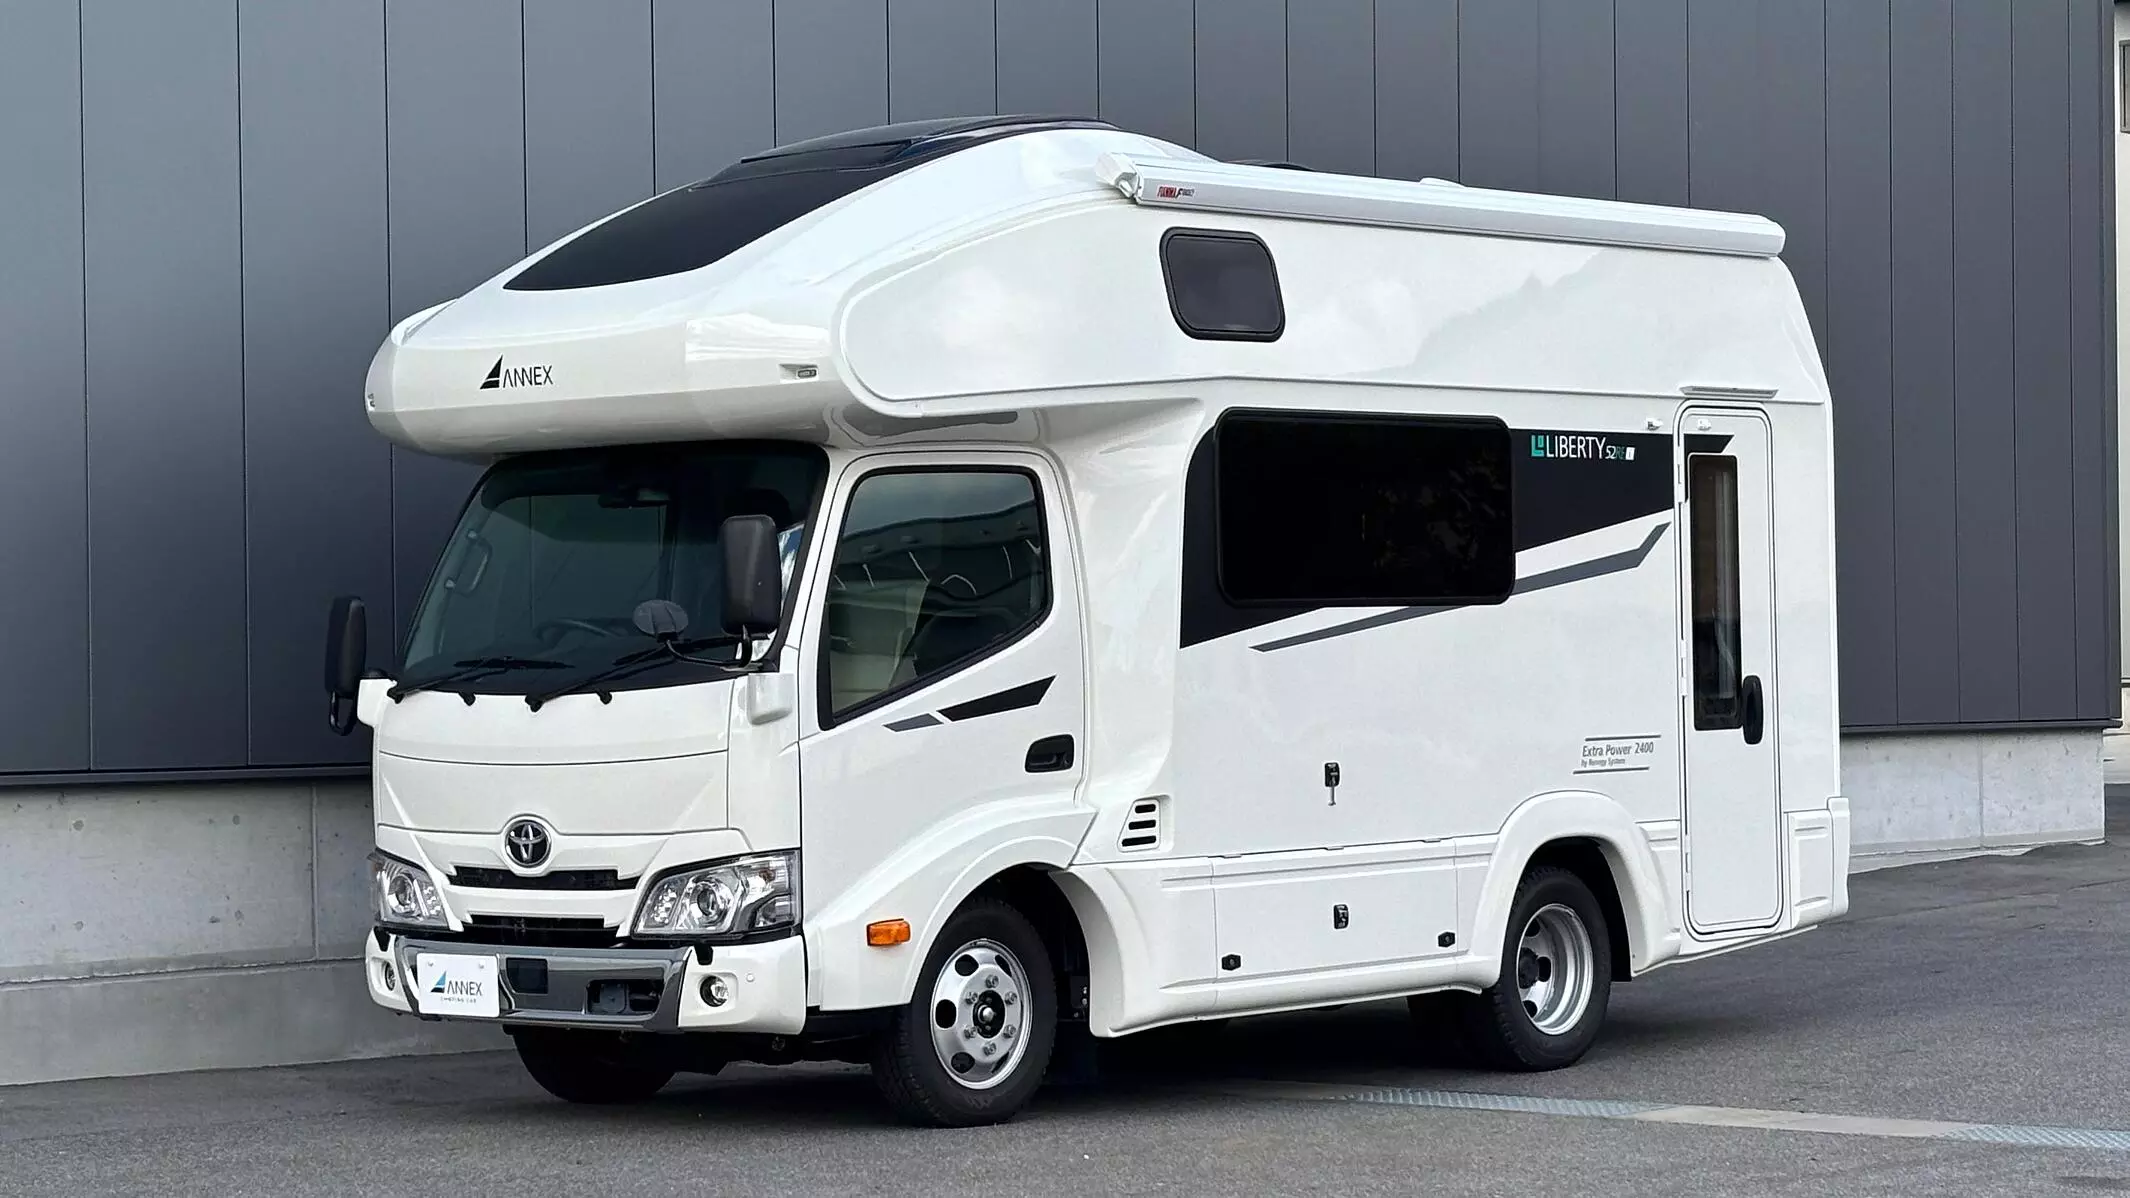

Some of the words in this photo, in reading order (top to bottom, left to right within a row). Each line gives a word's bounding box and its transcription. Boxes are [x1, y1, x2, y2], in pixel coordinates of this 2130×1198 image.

[503, 364, 554, 389] ANNEX
[1546, 435, 1606, 459] LIBERTY
[1582, 745, 1604, 757] Extra
[1605, 744, 1632, 756] Power
[1634, 742, 1654, 754] 2400
[447, 980, 482, 996] ANNEX
